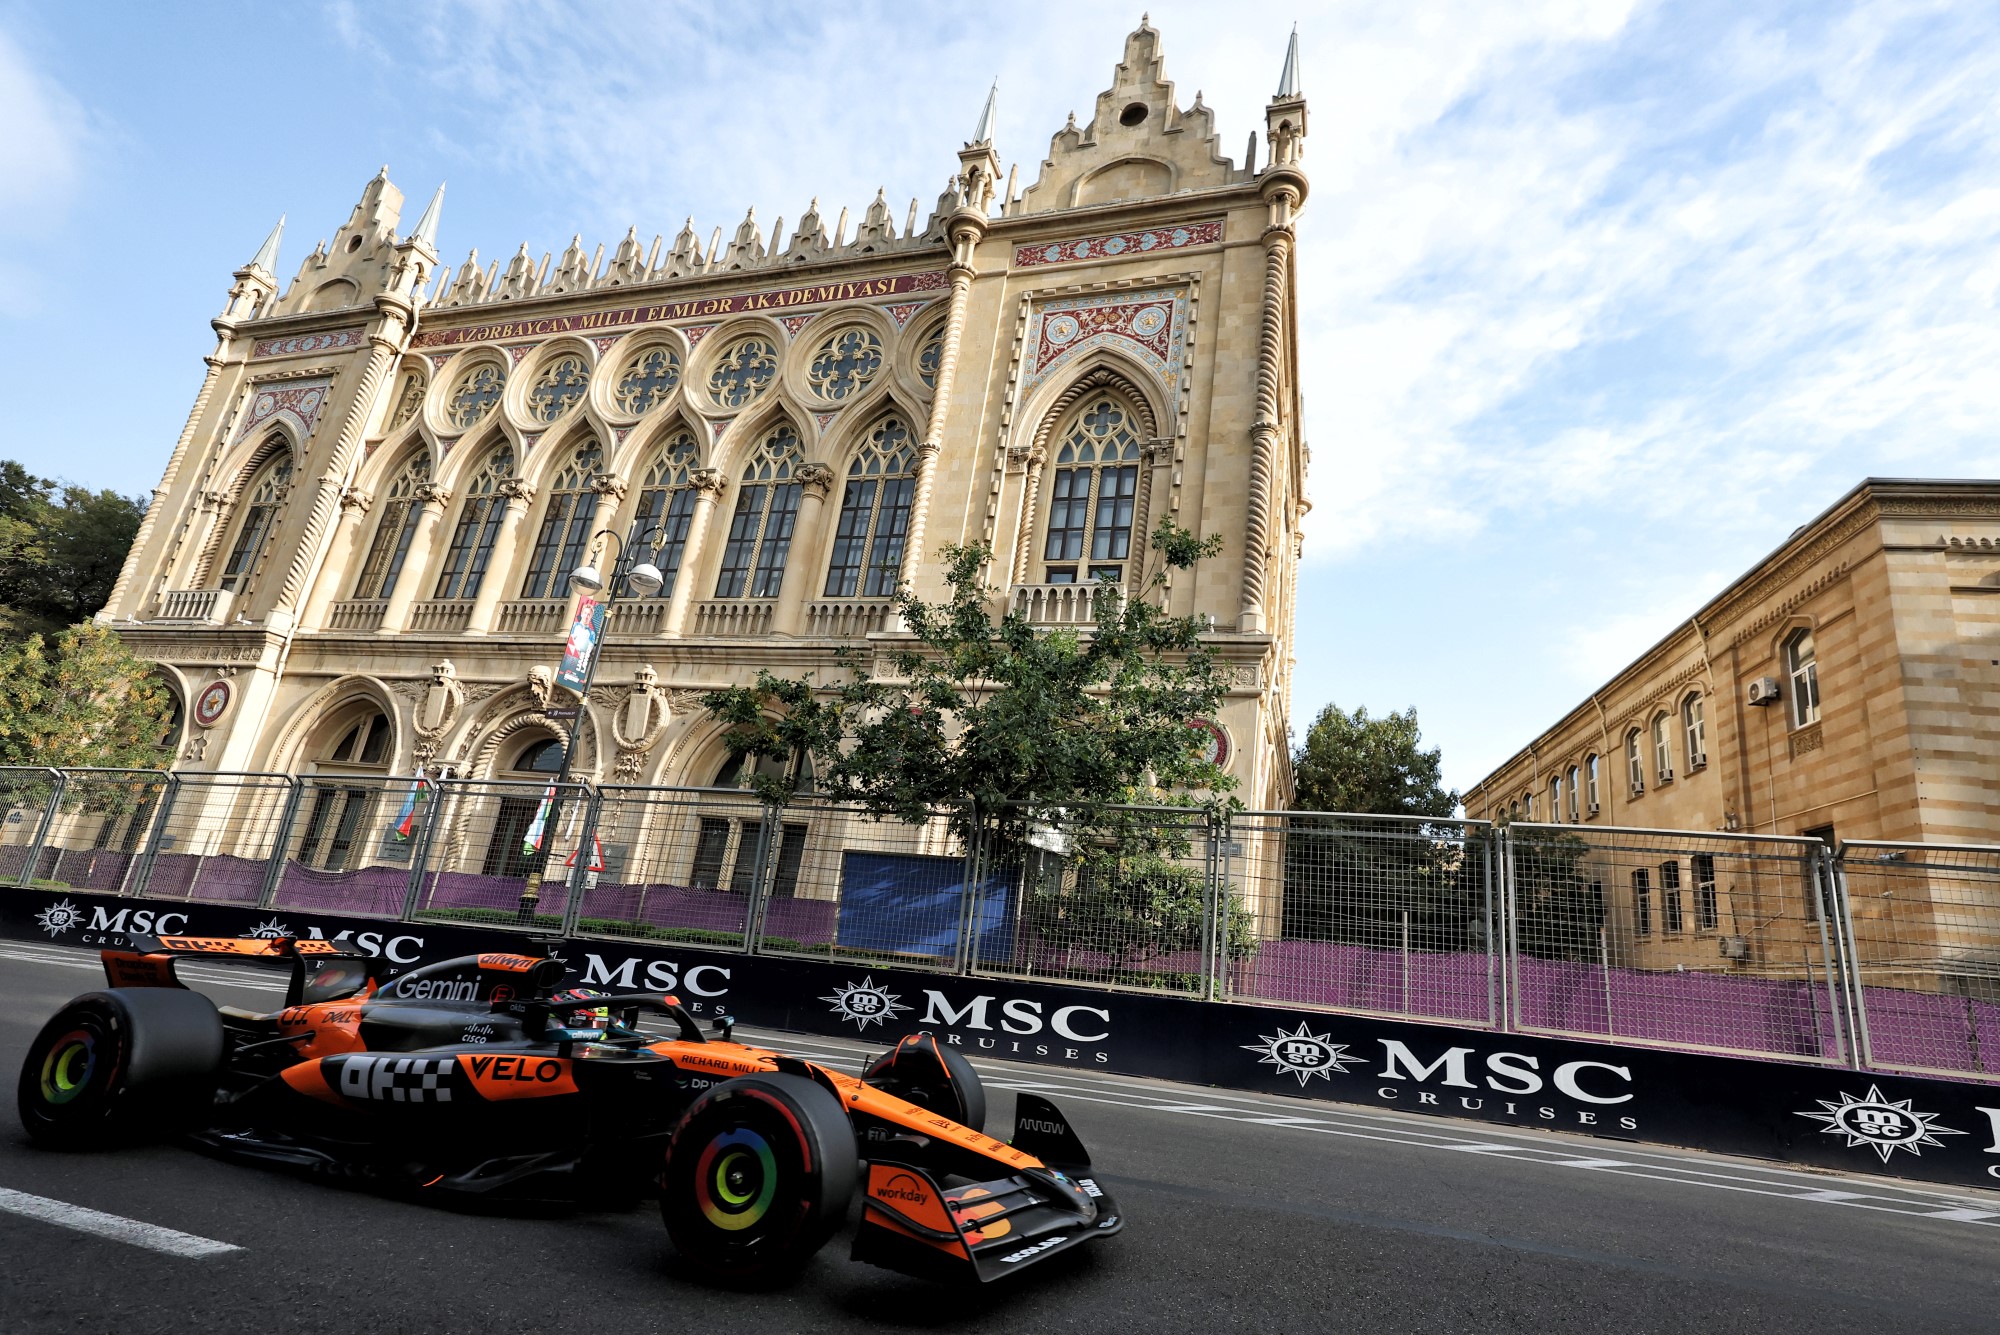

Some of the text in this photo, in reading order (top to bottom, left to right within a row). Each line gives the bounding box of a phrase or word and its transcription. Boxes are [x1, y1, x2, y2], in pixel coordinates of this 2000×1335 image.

[453, 278, 900, 343] AZƏRBAYCAN MİLLİ ELMLƏR AKADEMİYASI
[86, 905, 189, 936] MSC
[480, 954, 533, 970] allwyn
[579, 953, 731, 997] MSC
[396, 972, 482, 1002] Gemini
[321, 1011, 354, 1024] DELL
[919, 989, 1110, 1042] MSC
[571, 1029, 600, 1041] allwyn
[470, 1056, 562, 1083] VELO
[681, 1054, 729, 1070] RICHARD
[1377, 1038, 1634, 1105] MSC
[1377, 1087, 1638, 1130] CRUISES
[1018, 1118, 1065, 1136] ARROW
[877, 1187, 929, 1206] workday
[1000, 1236, 1068, 1263] ECOLAB
